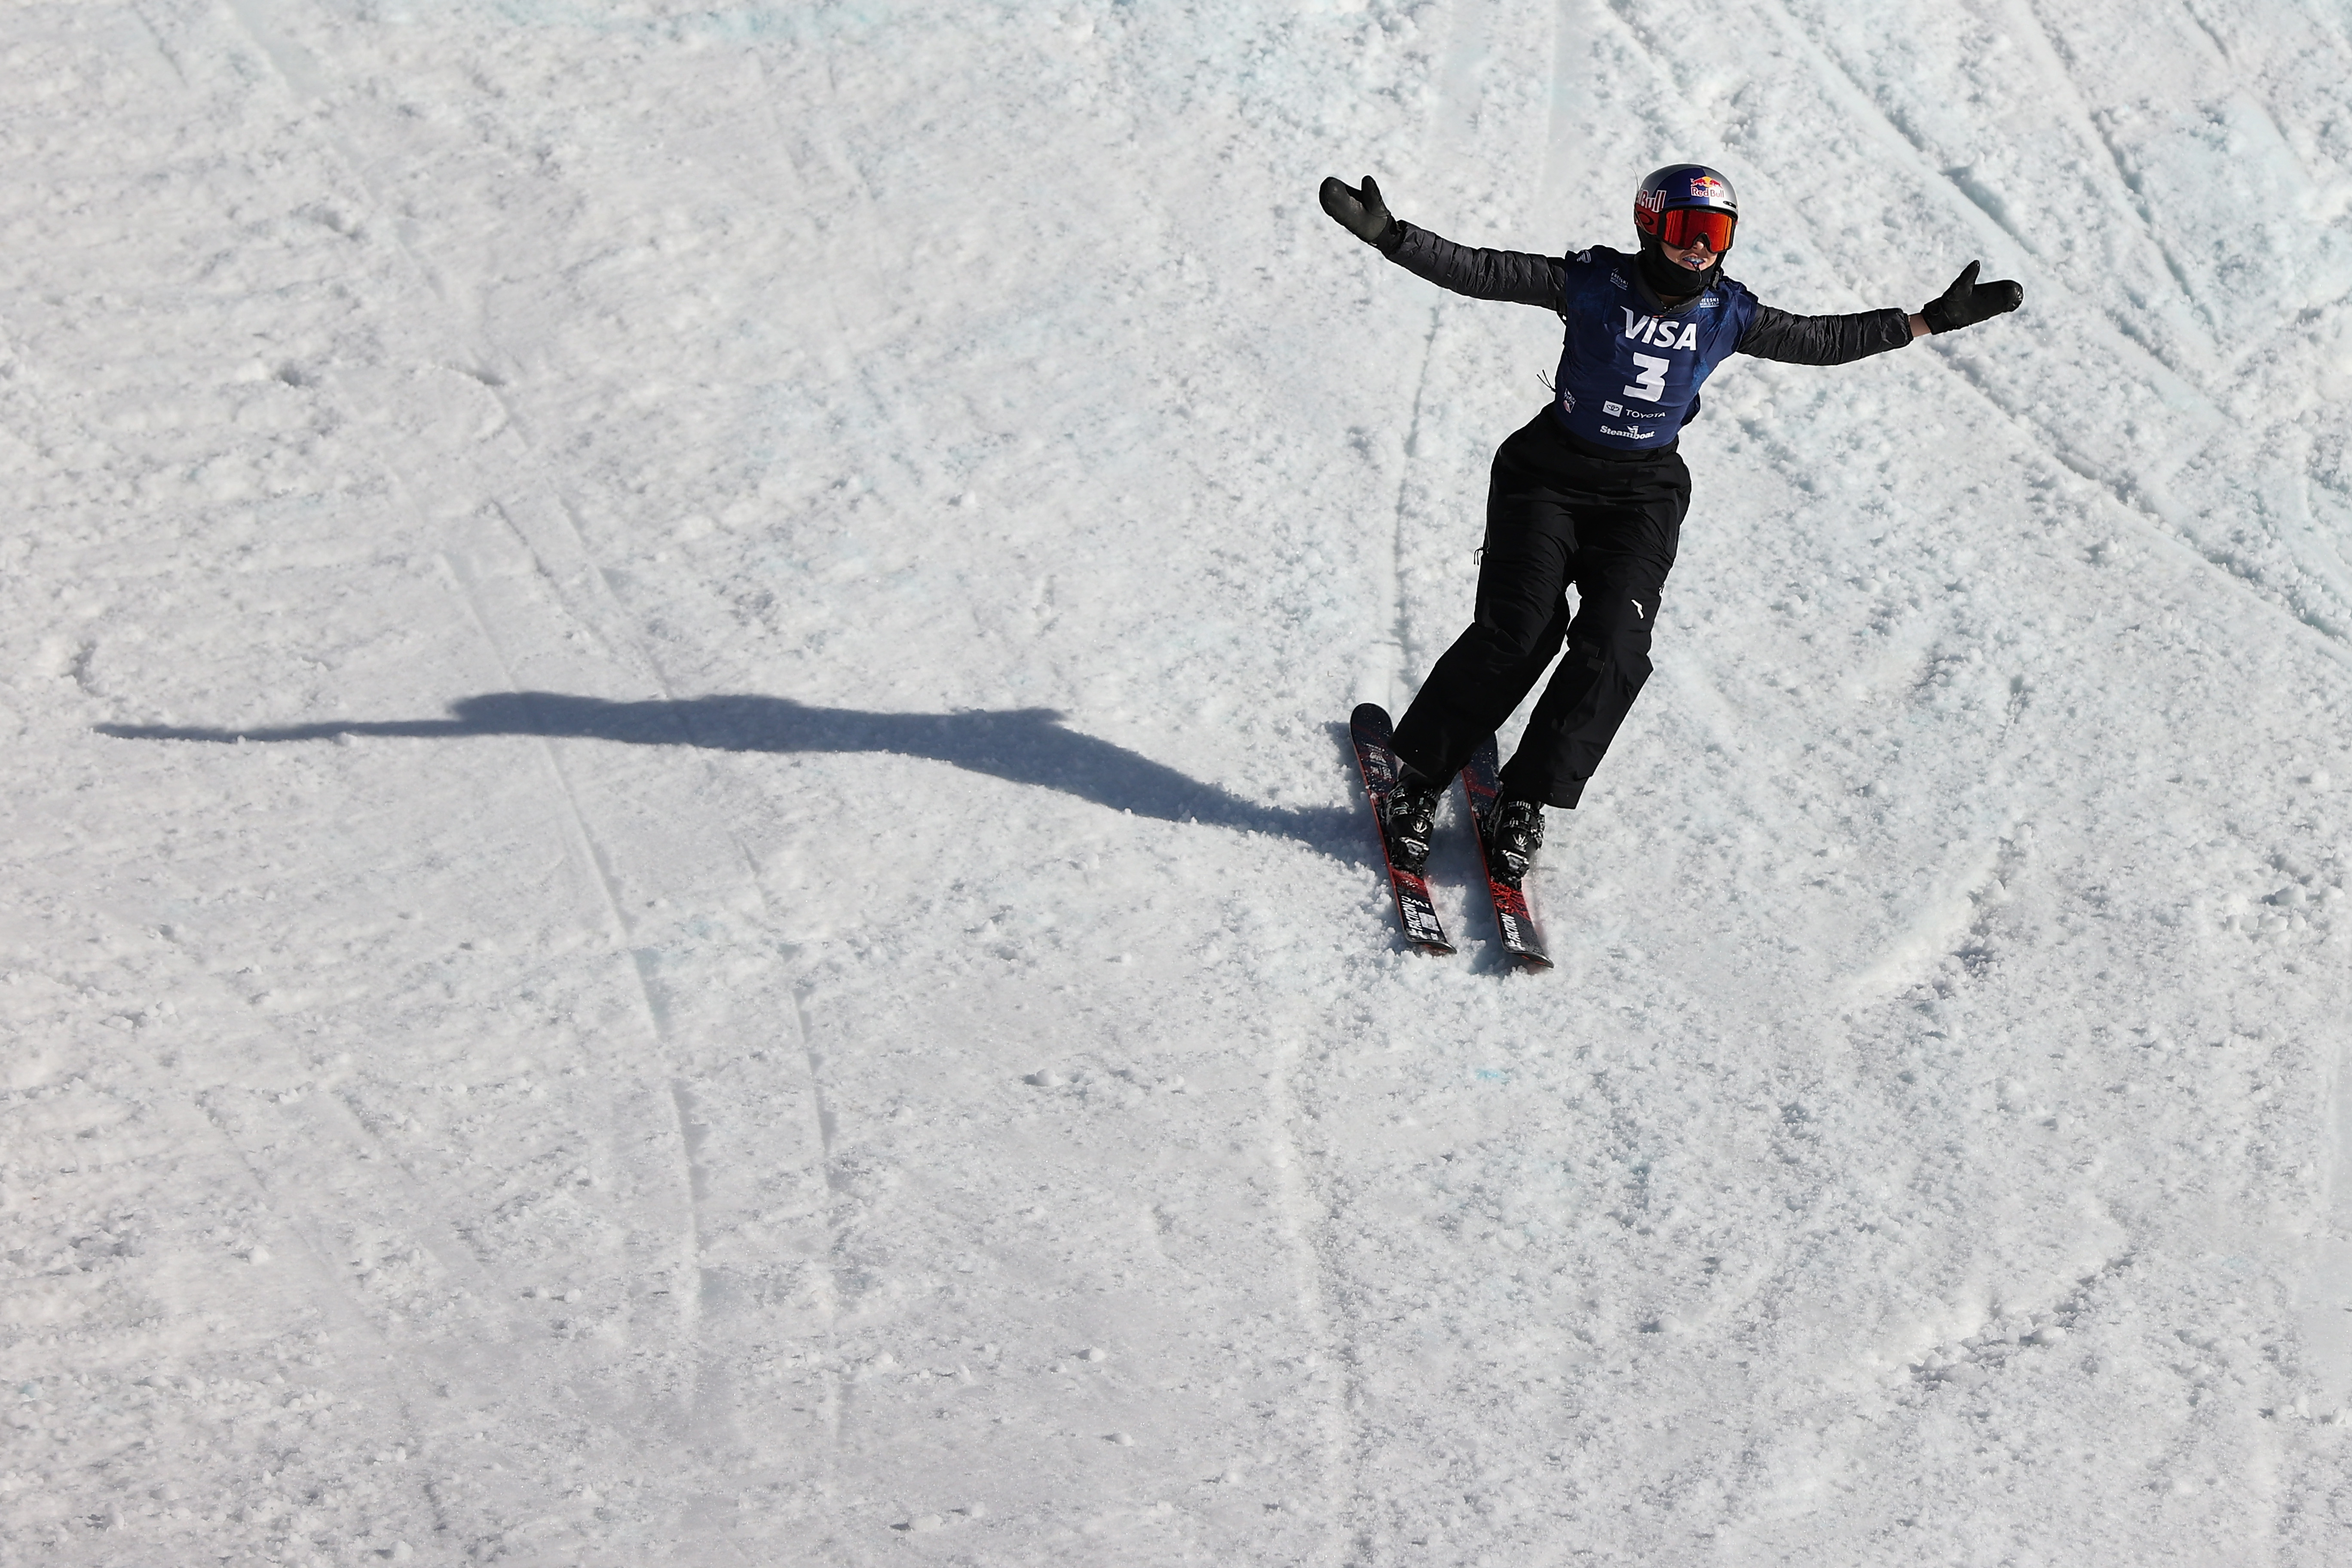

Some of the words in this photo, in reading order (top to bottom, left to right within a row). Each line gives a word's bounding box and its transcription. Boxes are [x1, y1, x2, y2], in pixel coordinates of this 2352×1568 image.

[1691, 187, 1709, 197] Red
[1710, 189, 1724, 198] Bull
[1620, 306, 1697, 351] VISA
[1623, 352, 1670, 402] 3
[1626, 409, 1666, 418] TOYOTA
[1600, 425, 1655, 439] Steamboat
[1401, 901, 1423, 931] FACTION
[1501, 913, 1521, 943] FACTION
